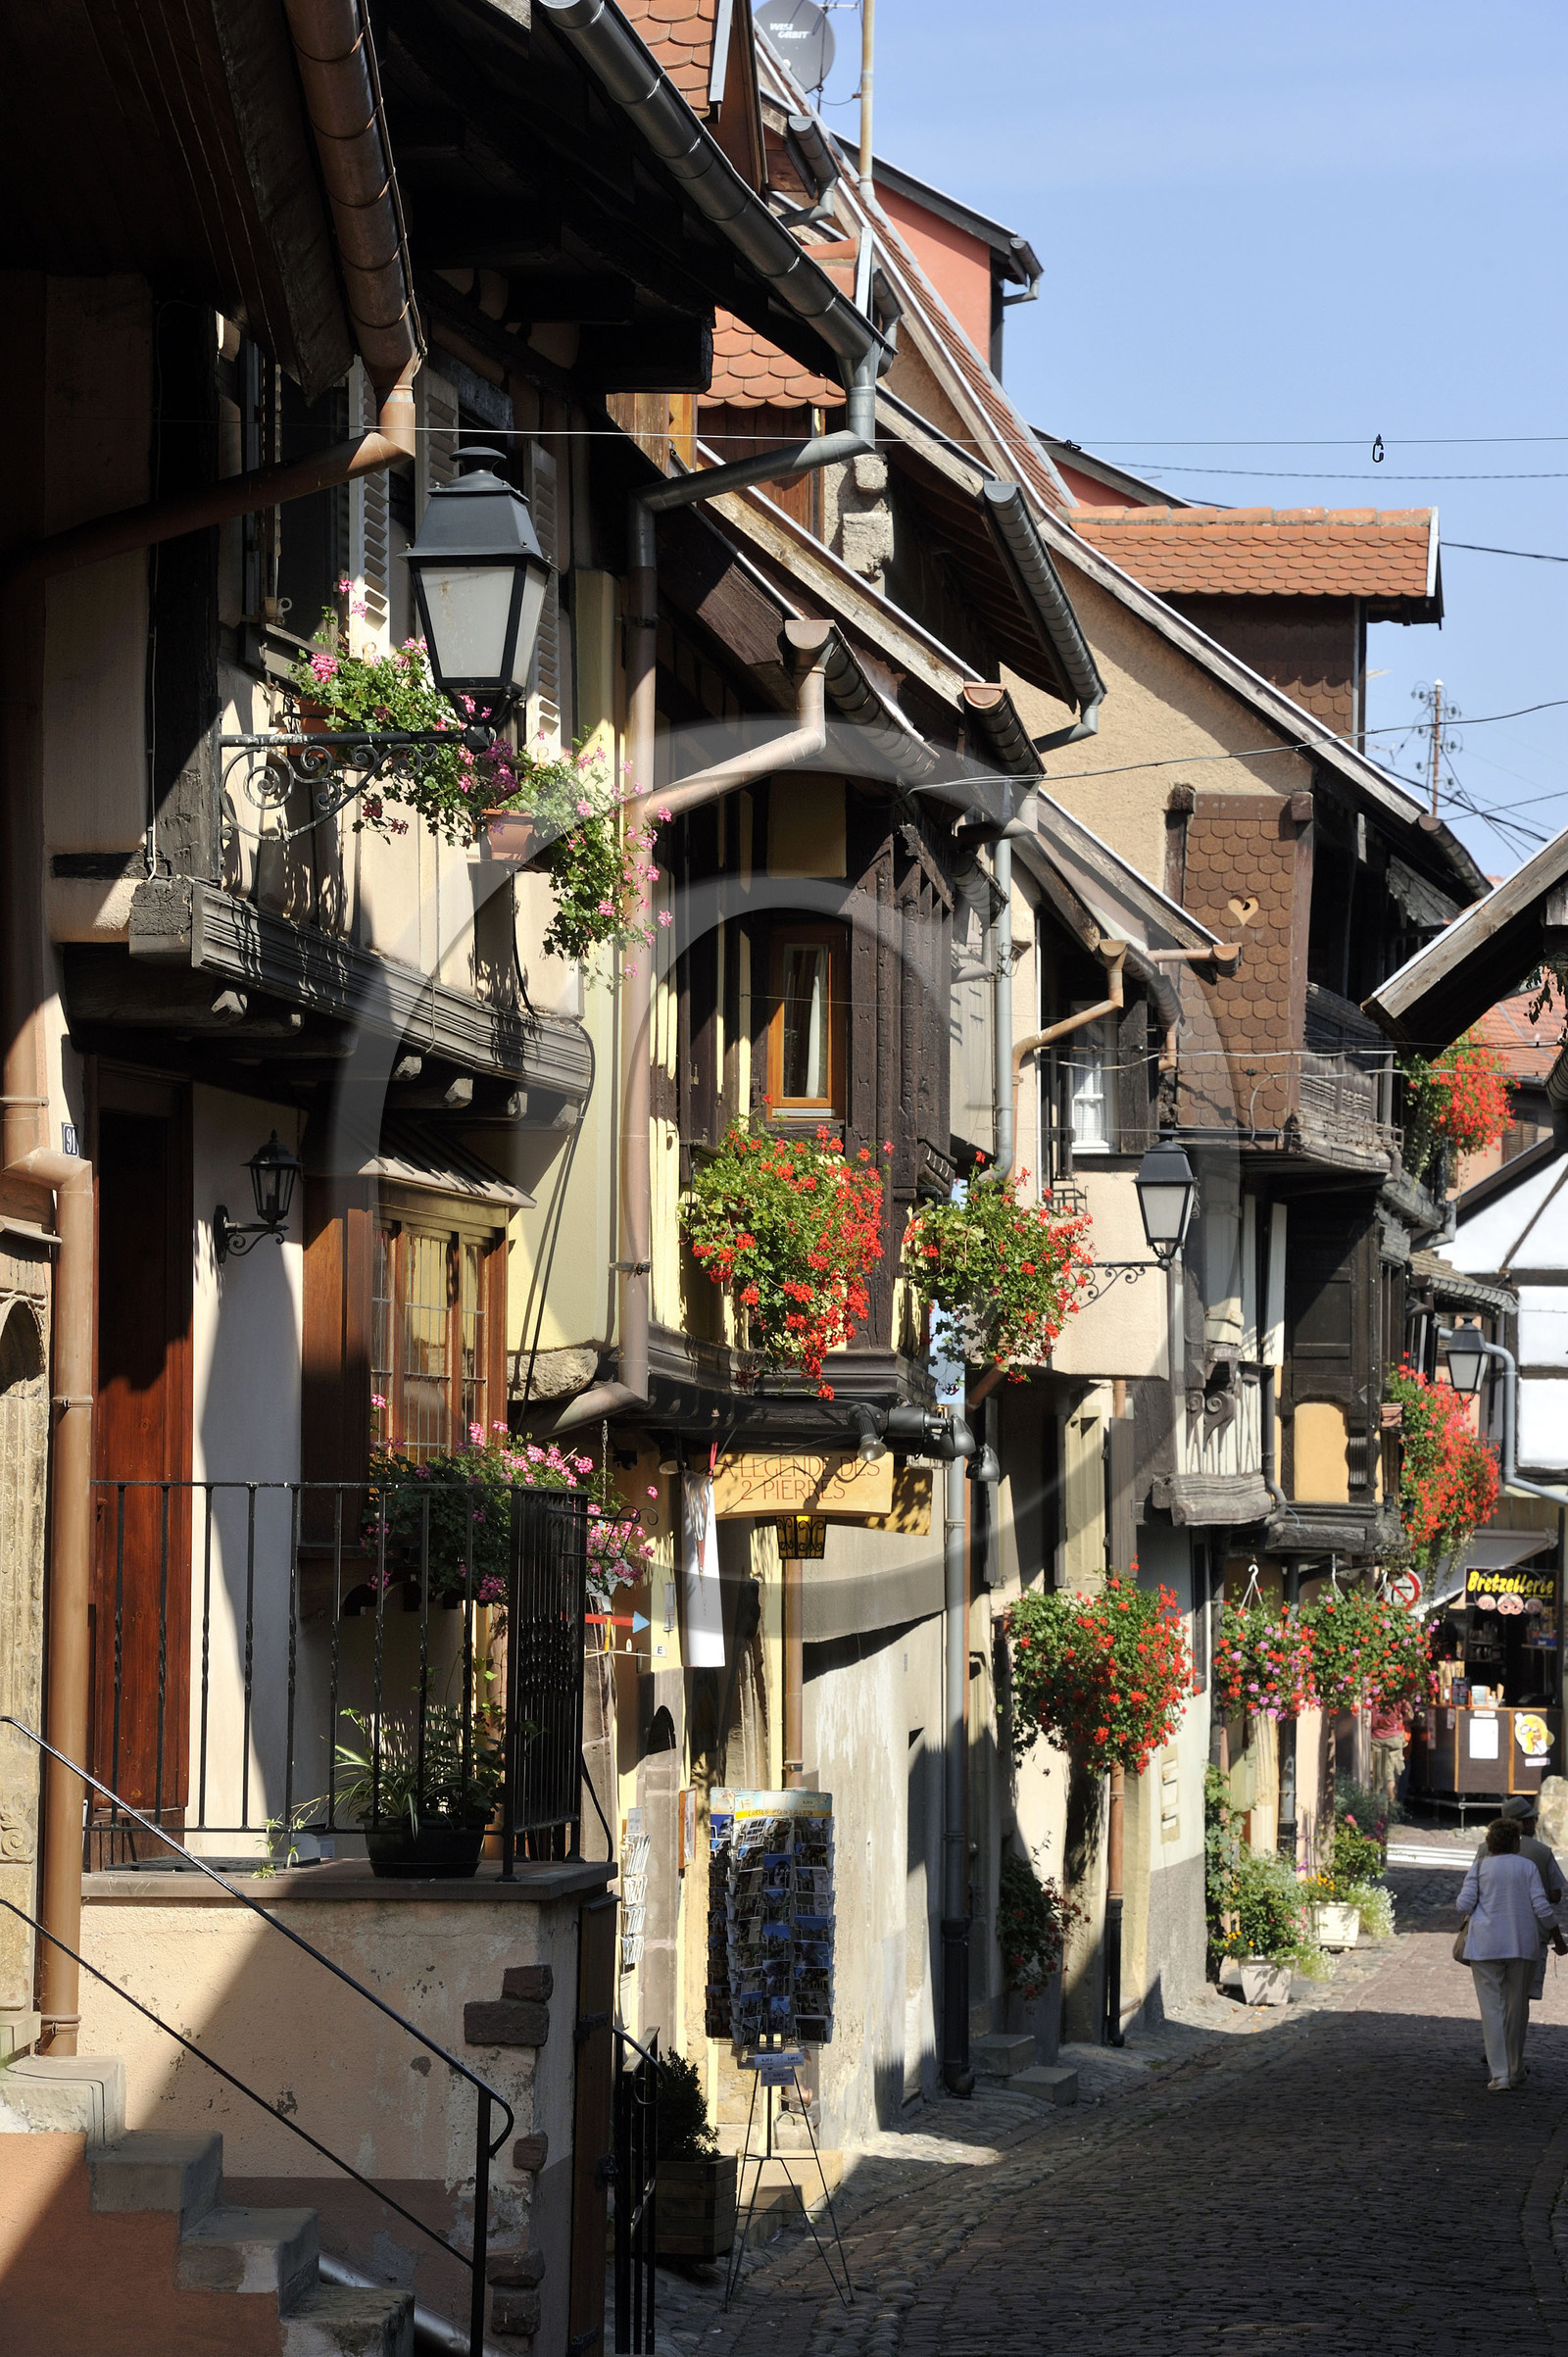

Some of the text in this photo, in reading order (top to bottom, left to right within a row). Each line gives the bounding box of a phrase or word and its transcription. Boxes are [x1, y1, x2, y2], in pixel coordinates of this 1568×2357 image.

[769, 23, 794, 31] WISI
[66, 1127, 76, 1154] 91
[741, 1456, 833, 1478] LEGENDE
[840, 1456, 880, 1477] DES
[742, 1479, 846, 1501] 2 PIERRES
[1467, 1570, 1554, 1595] Bretzellerie
